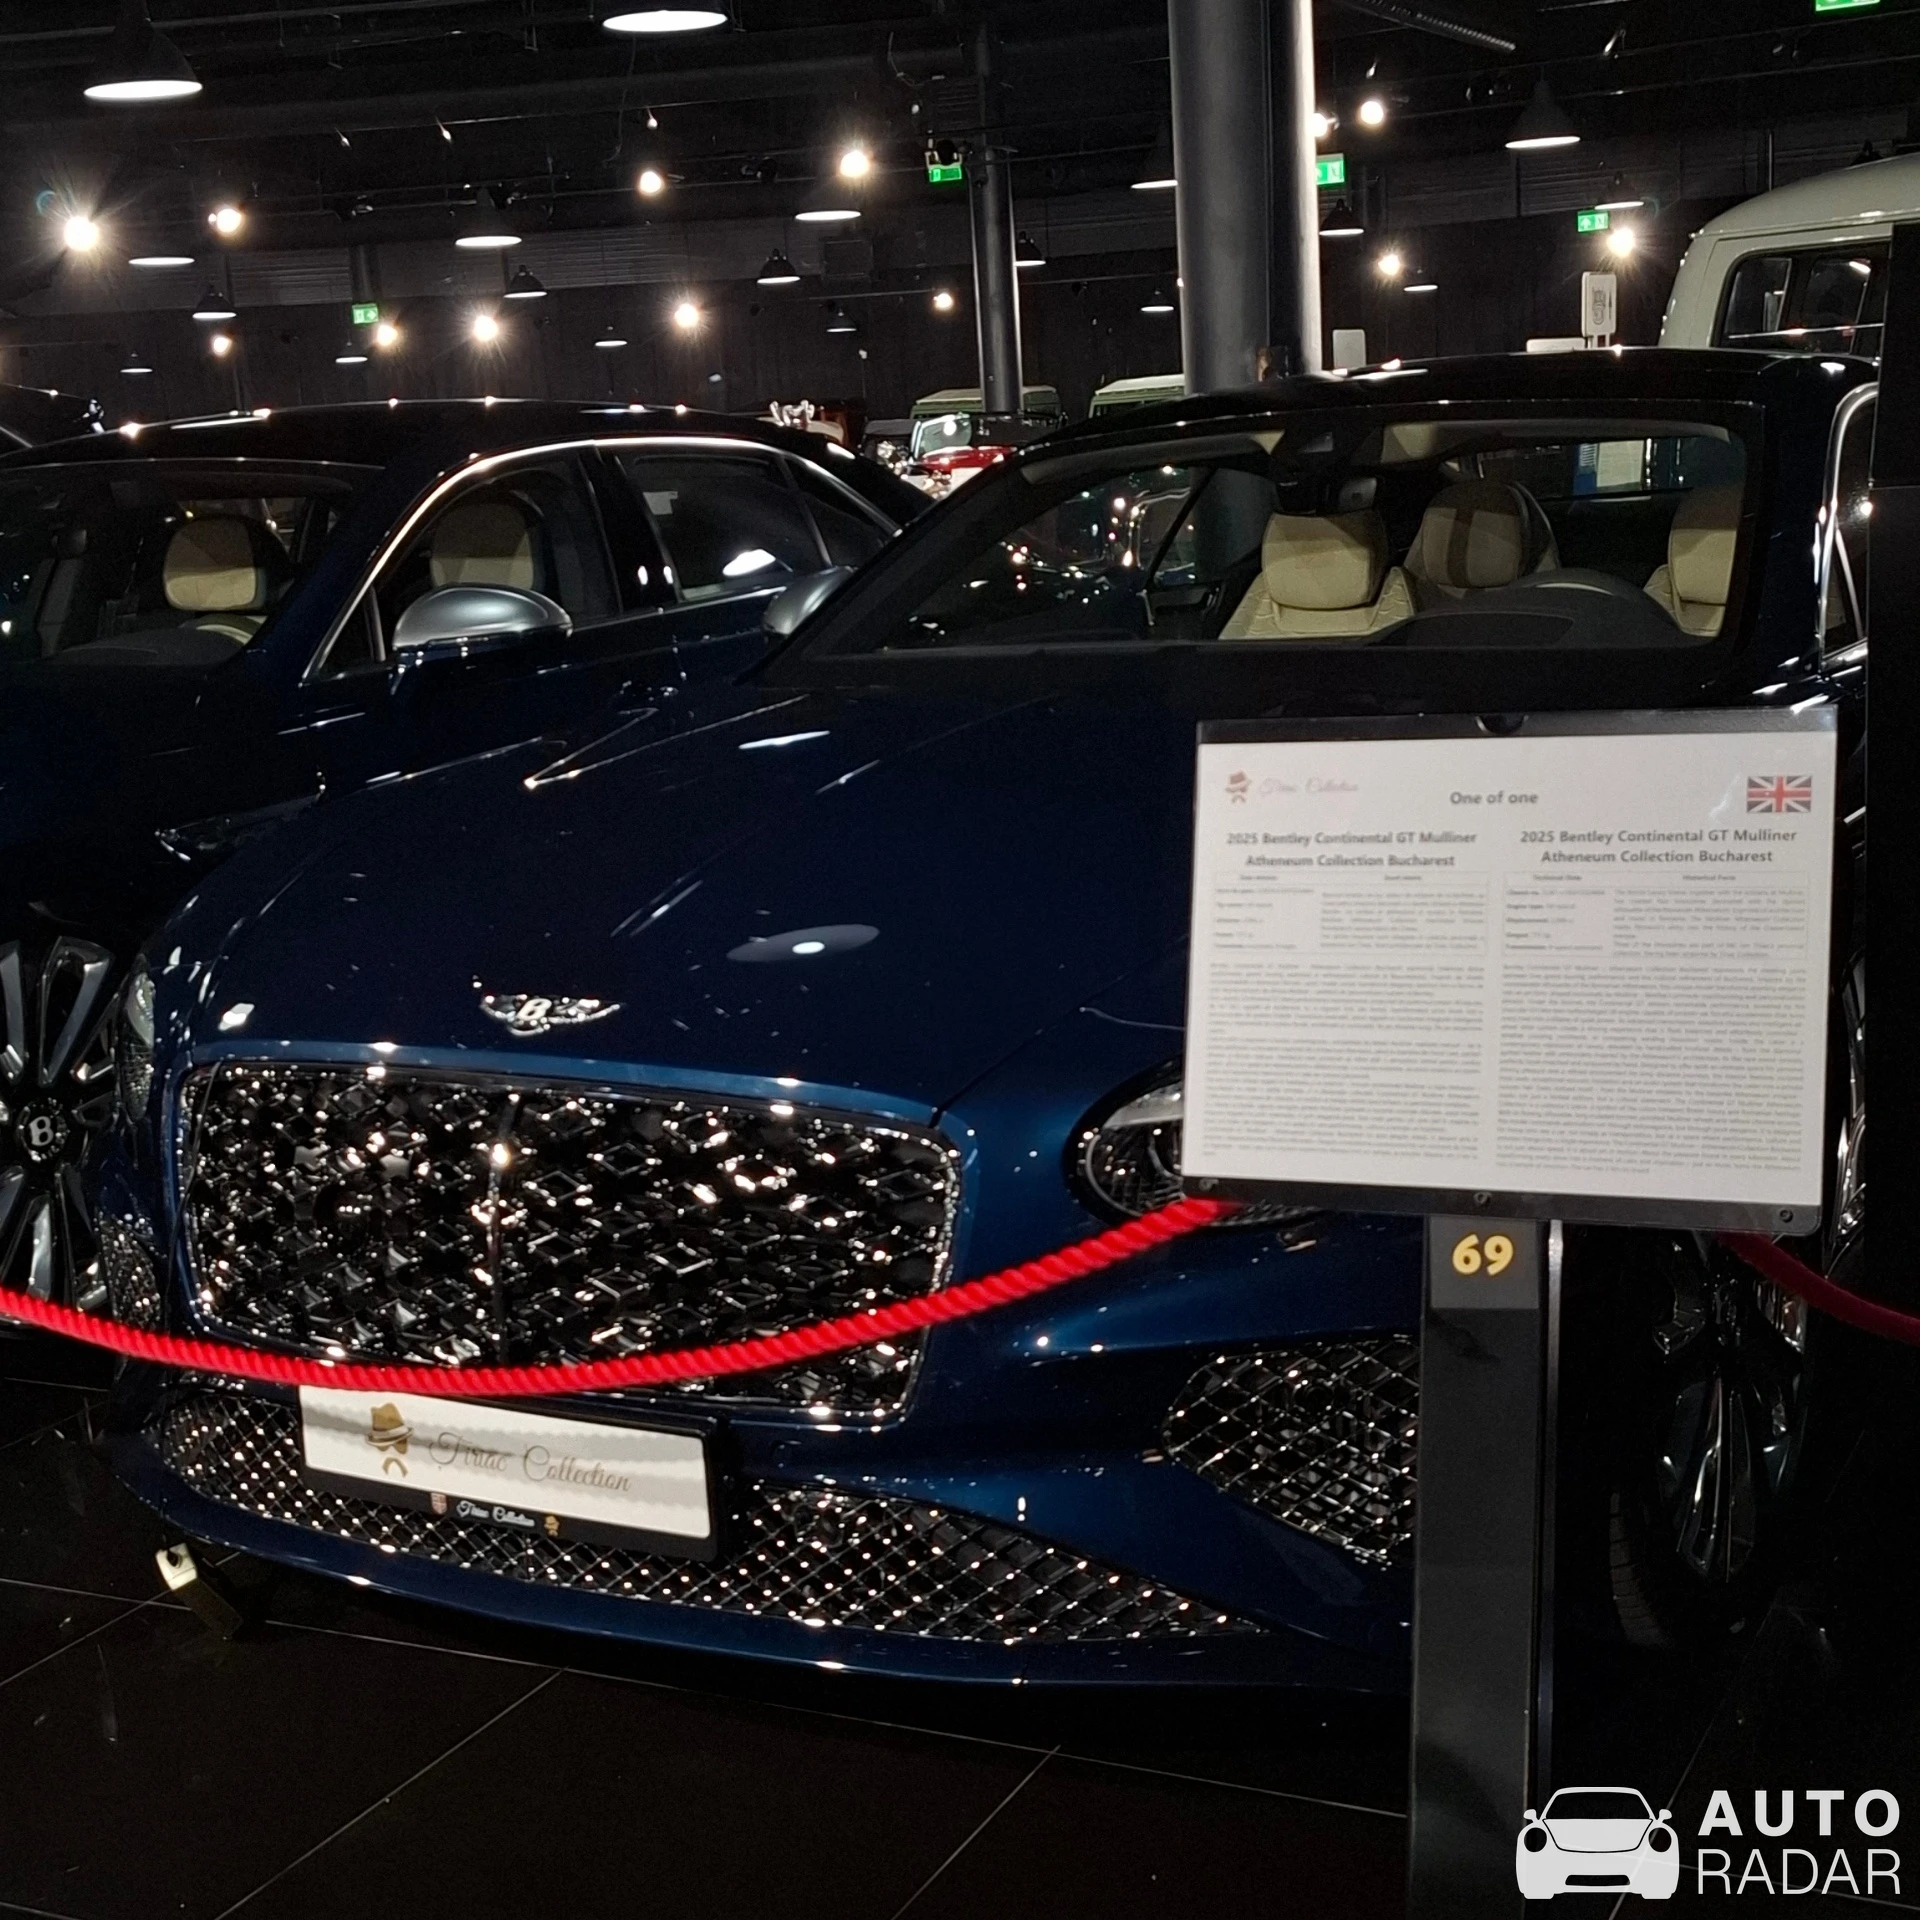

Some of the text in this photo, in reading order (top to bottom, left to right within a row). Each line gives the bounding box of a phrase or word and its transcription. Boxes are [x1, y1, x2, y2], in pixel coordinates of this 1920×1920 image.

[1450, 790, 1538, 805] One of one
[1262, 832, 1311, 848] Bentley
[1315, 831, 1393, 844] Continental
[1396, 831, 1415, 843] GT
[1520, 828, 1797, 846] 2025 Bentley Continental GT Mulliner
[1317, 854, 1384, 866] Collection
[1540, 848, 1773, 863] Atheneum Collection Bucharest
[29, 1115, 54, 1147] B
[1452, 1233, 1514, 1275] 69
[523, 1444, 630, 1491] Collection
